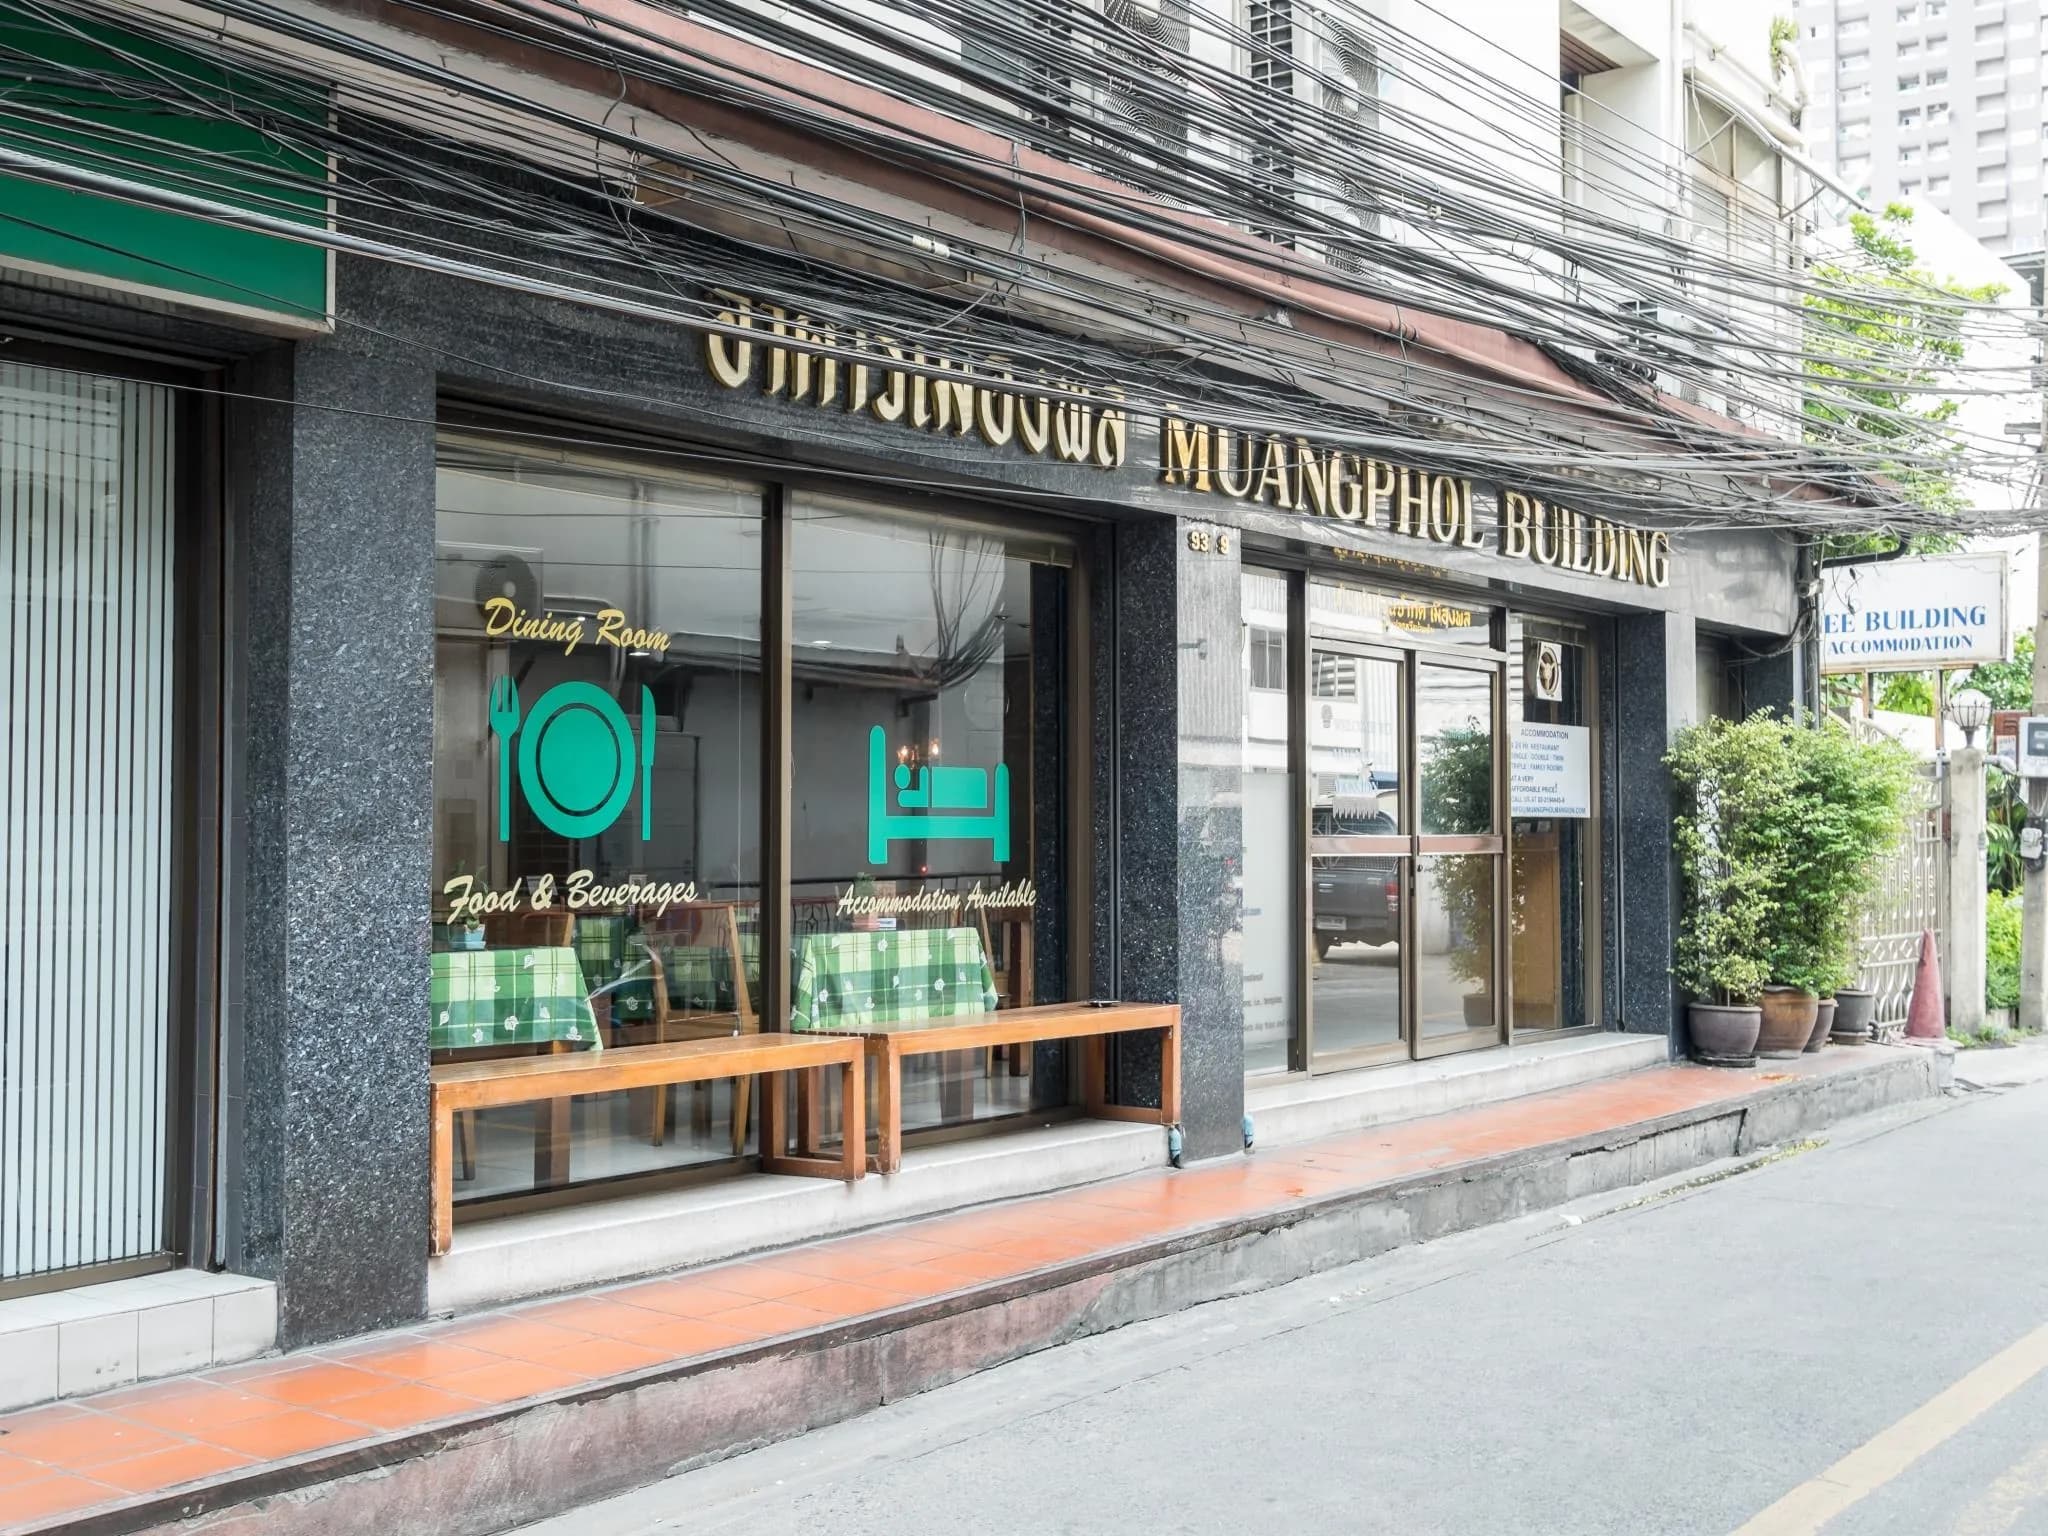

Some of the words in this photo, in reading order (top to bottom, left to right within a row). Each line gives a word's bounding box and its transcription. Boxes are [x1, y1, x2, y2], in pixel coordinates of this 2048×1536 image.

[705, 288, 1126, 468] อาคารเมองพล
[1160, 404, 1485, 548] MUANGPHOL
[1502, 489, 1671, 589] BUILDING
[1188, 531, 1209, 553] 93
[1217, 534, 1229, 555] 9
[484, 597, 586, 657] Dining
[596, 608, 671, 652] Room
[1819, 614, 1855, 634] EE
[1866, 606, 1987, 632] BUILDING
[1828, 634, 1973, 656] ACCOMMODATION
[1520, 728, 1569, 740] ACCOMMODATION
[443, 874, 522, 924] Food
[531, 874, 553, 911] &
[565, 868, 699, 917] Beverages
[835, 883, 962, 917] Accommodation
[964, 878, 1037, 909] Available
